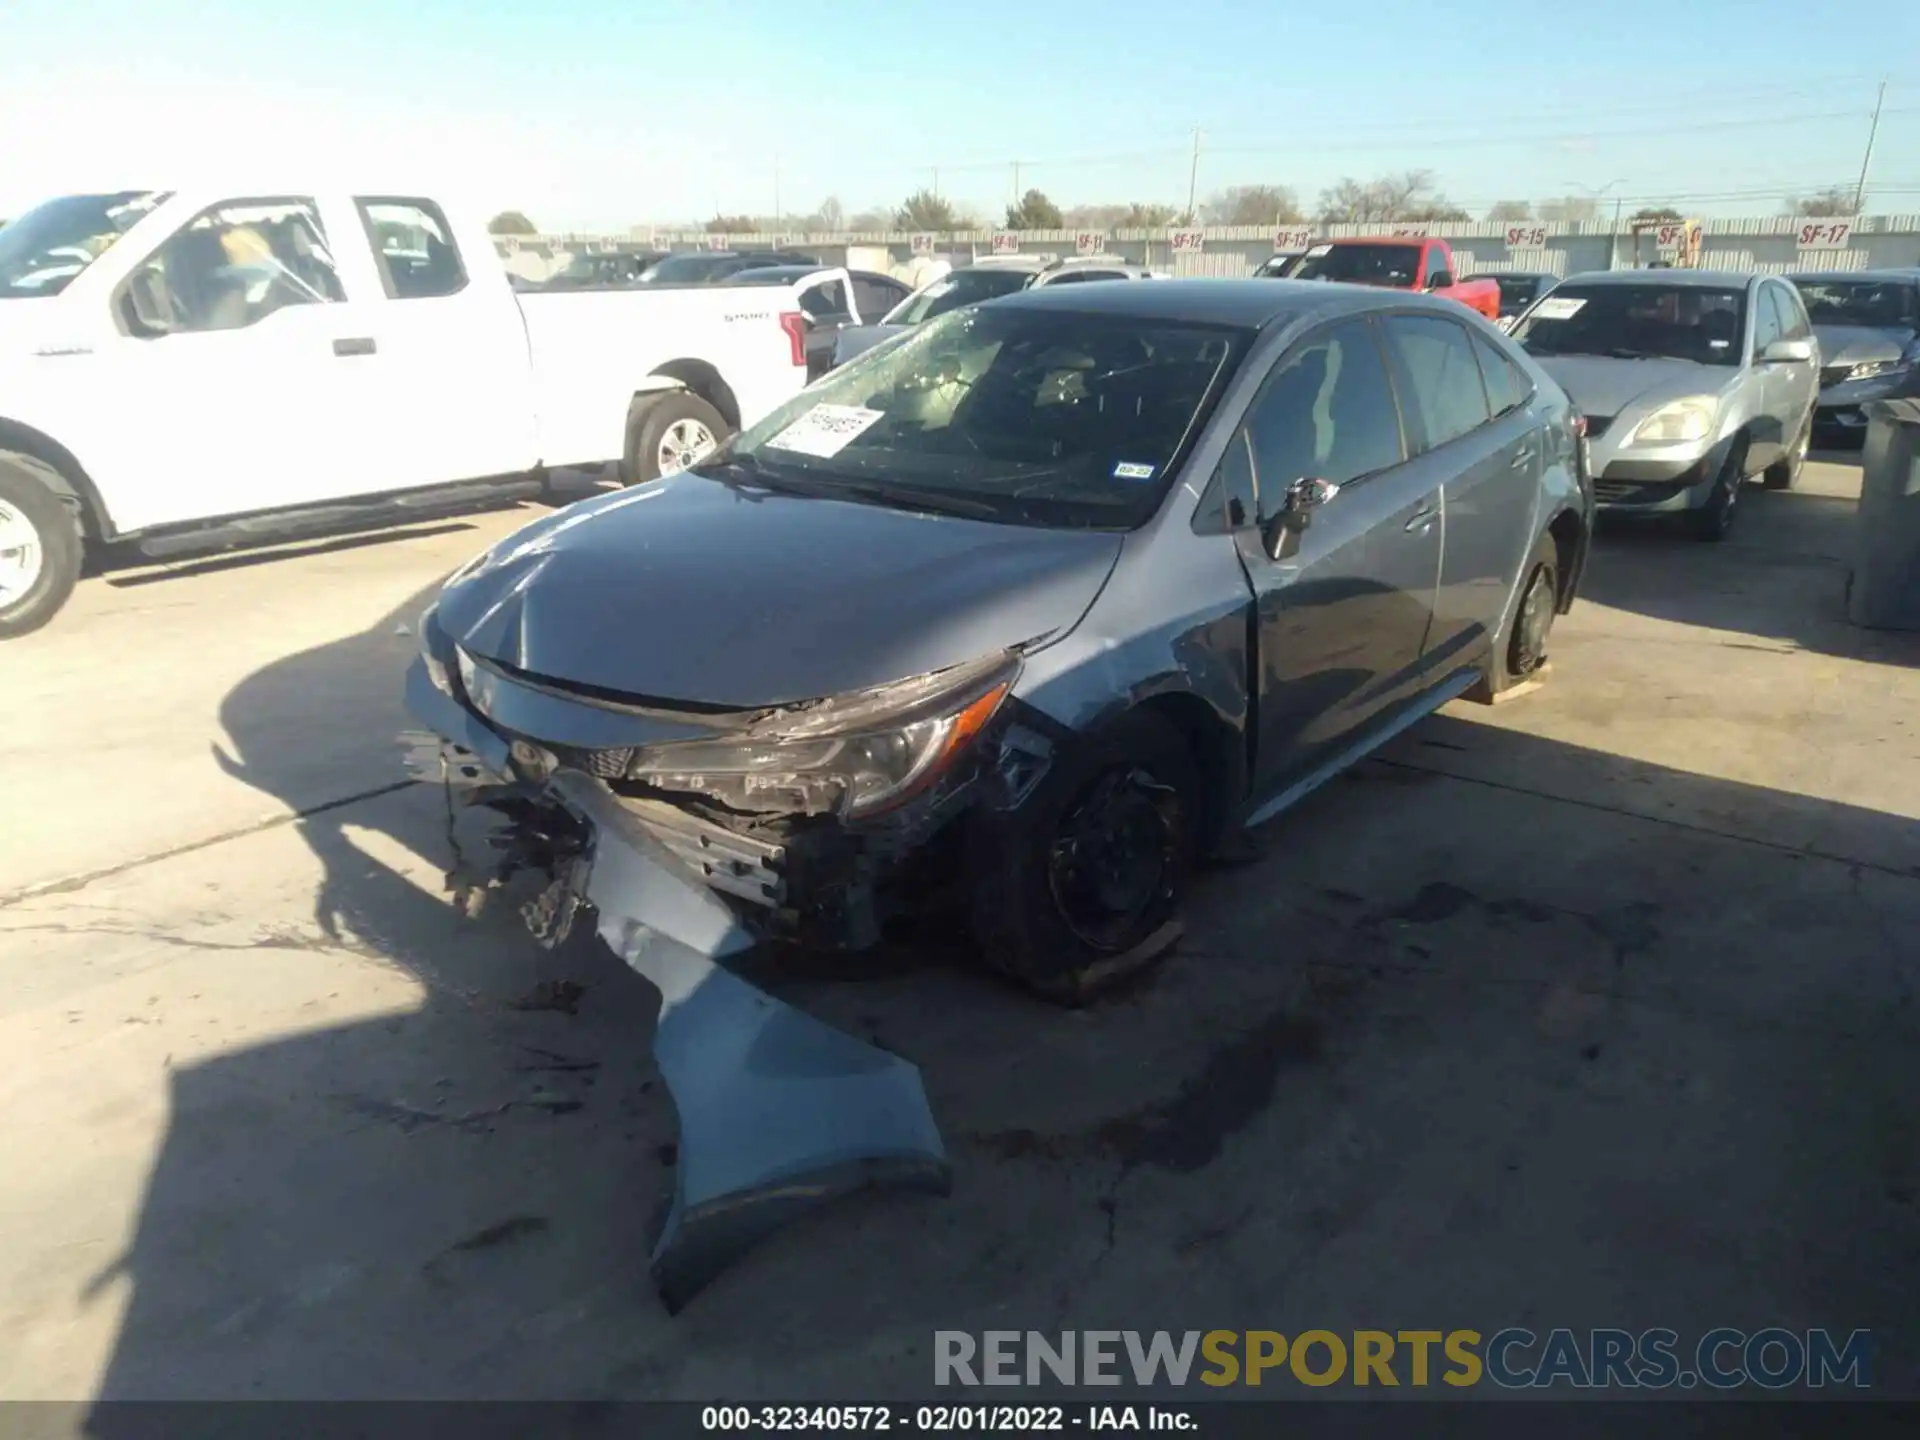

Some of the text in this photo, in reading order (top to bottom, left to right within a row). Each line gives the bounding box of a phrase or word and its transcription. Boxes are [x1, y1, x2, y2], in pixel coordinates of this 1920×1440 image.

[1173, 233, 1202, 248] SF-12
[1276, 231, 1307, 249] SF-13
[1507, 227, 1545, 245] SF-15
[1799, 224, 1848, 244] SF-17
